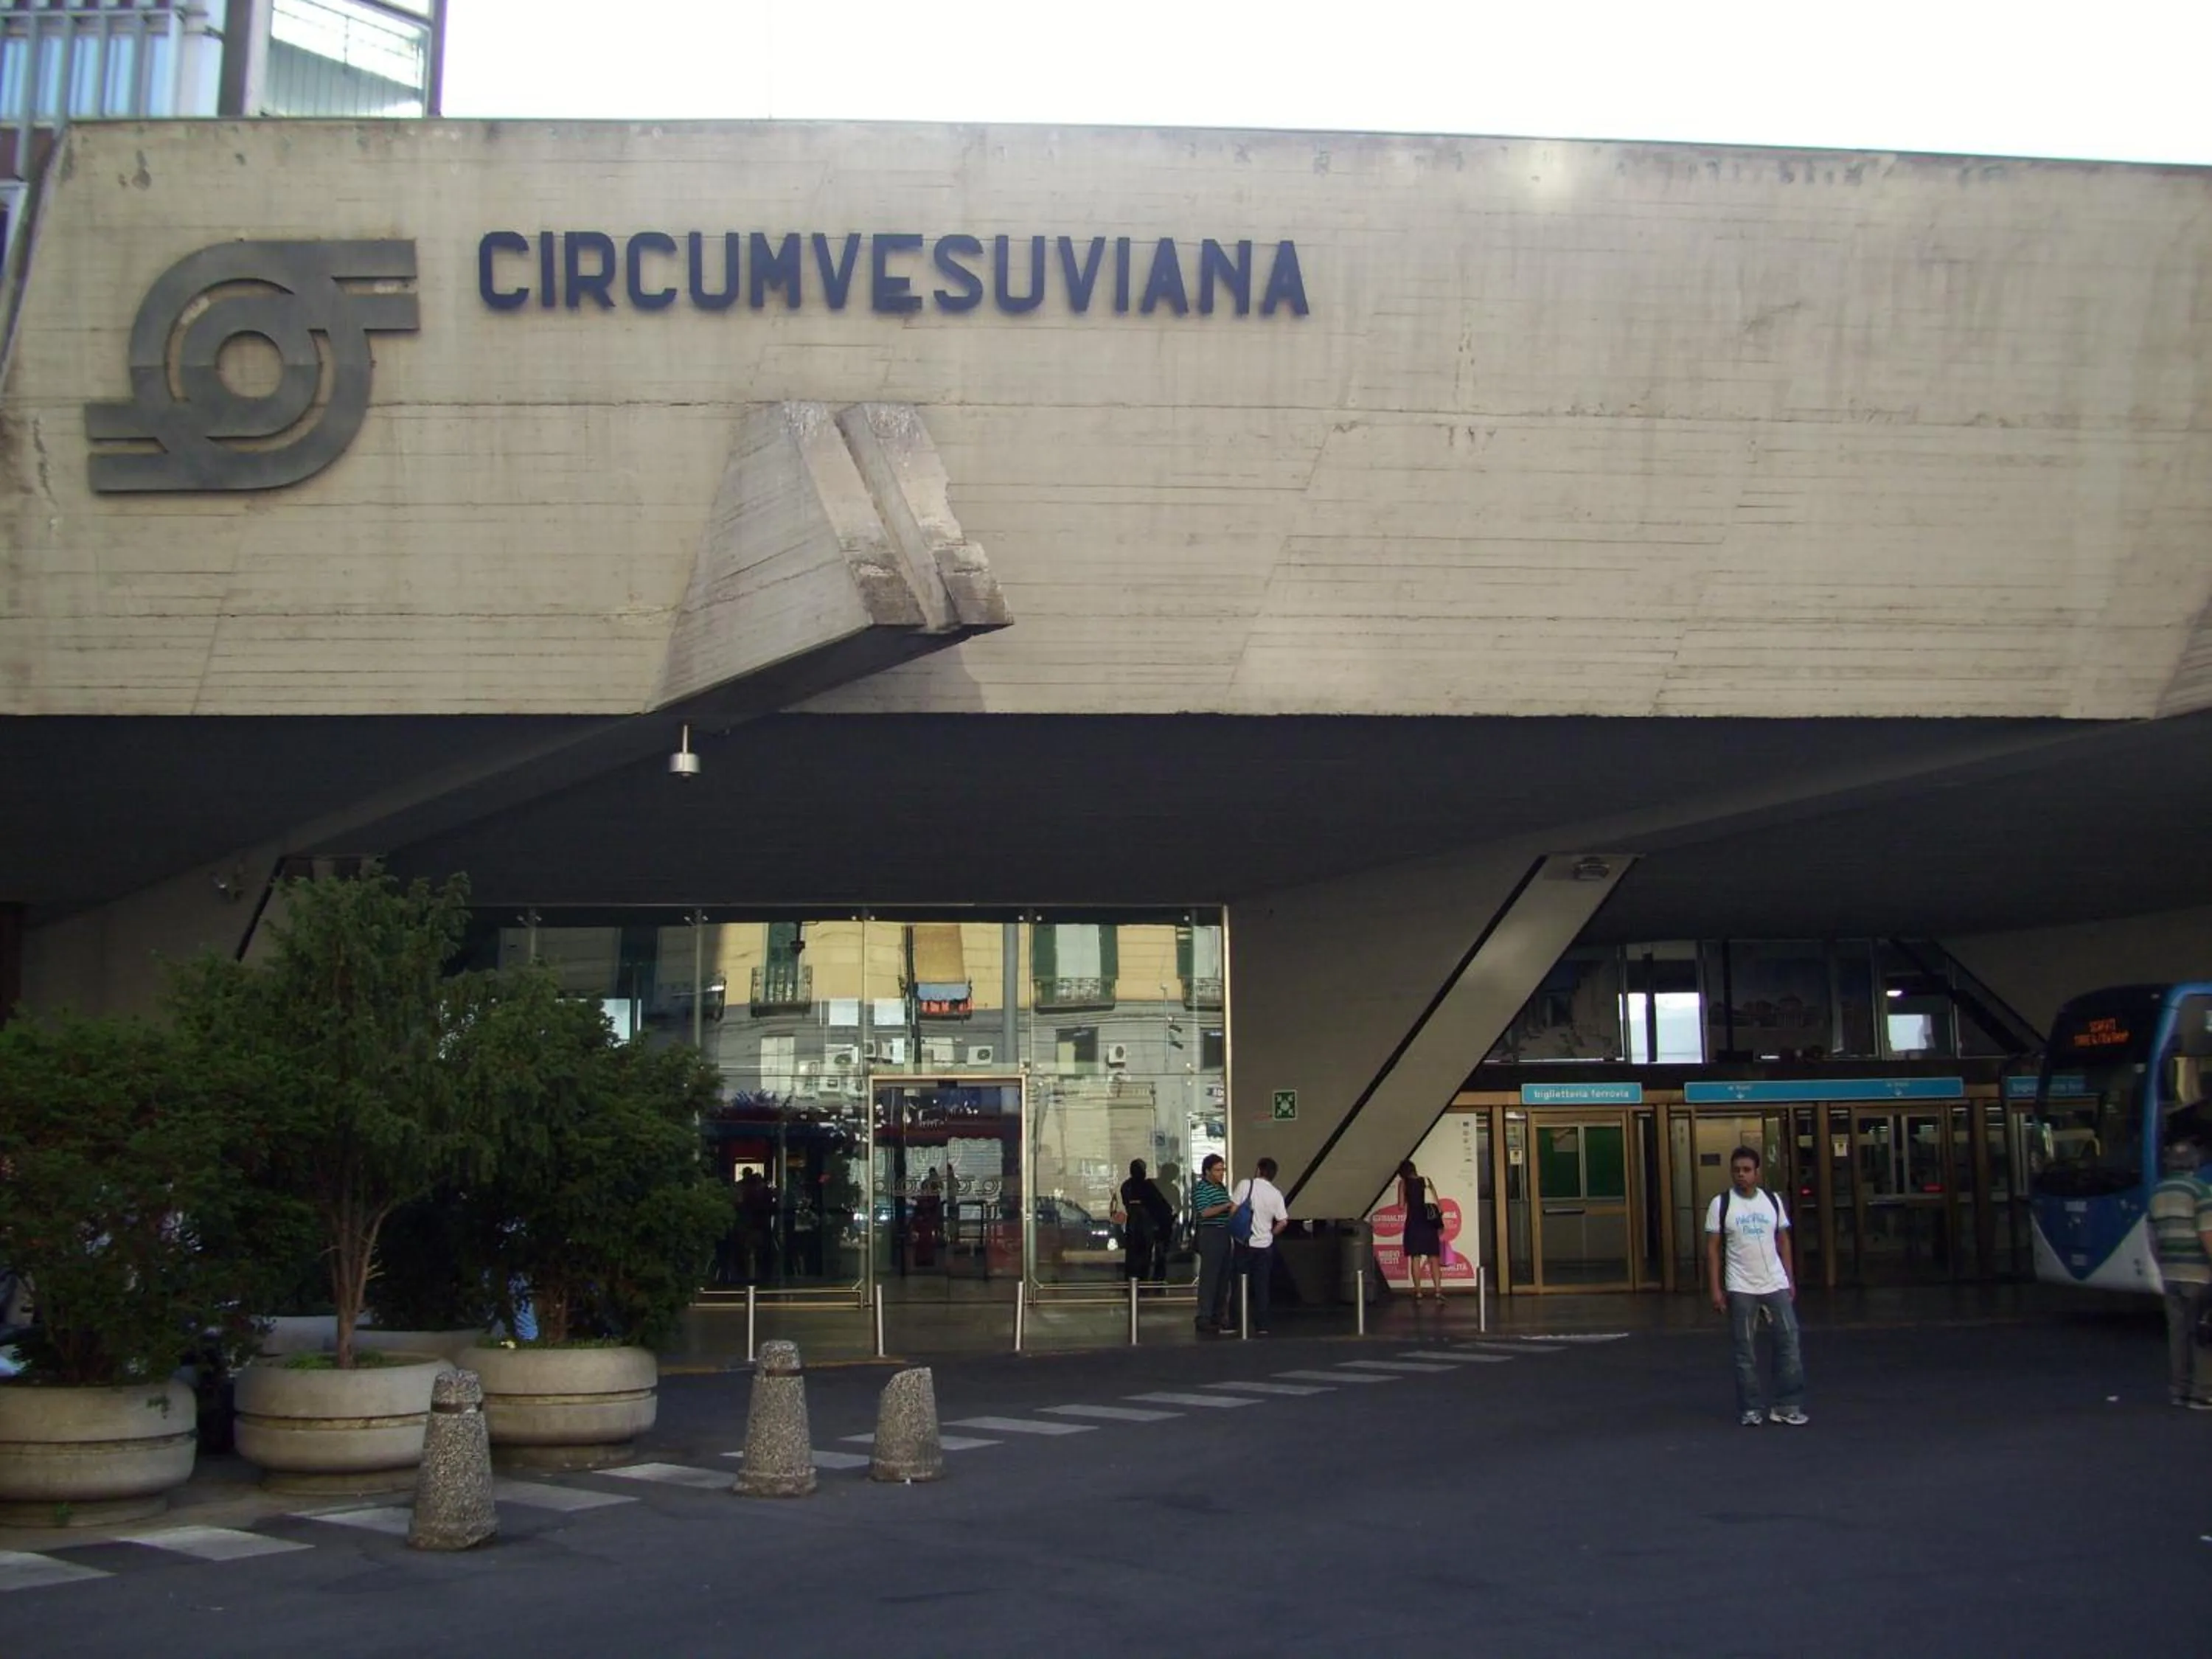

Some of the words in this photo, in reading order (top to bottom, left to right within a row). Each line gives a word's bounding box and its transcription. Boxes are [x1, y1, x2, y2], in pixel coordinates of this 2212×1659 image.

[478, 230, 1310, 318] CIRCUMVESUVIANA
[1533, 1089, 1589, 1099] biglietteria
[1591, 1088, 1630, 1098] ferrovia
